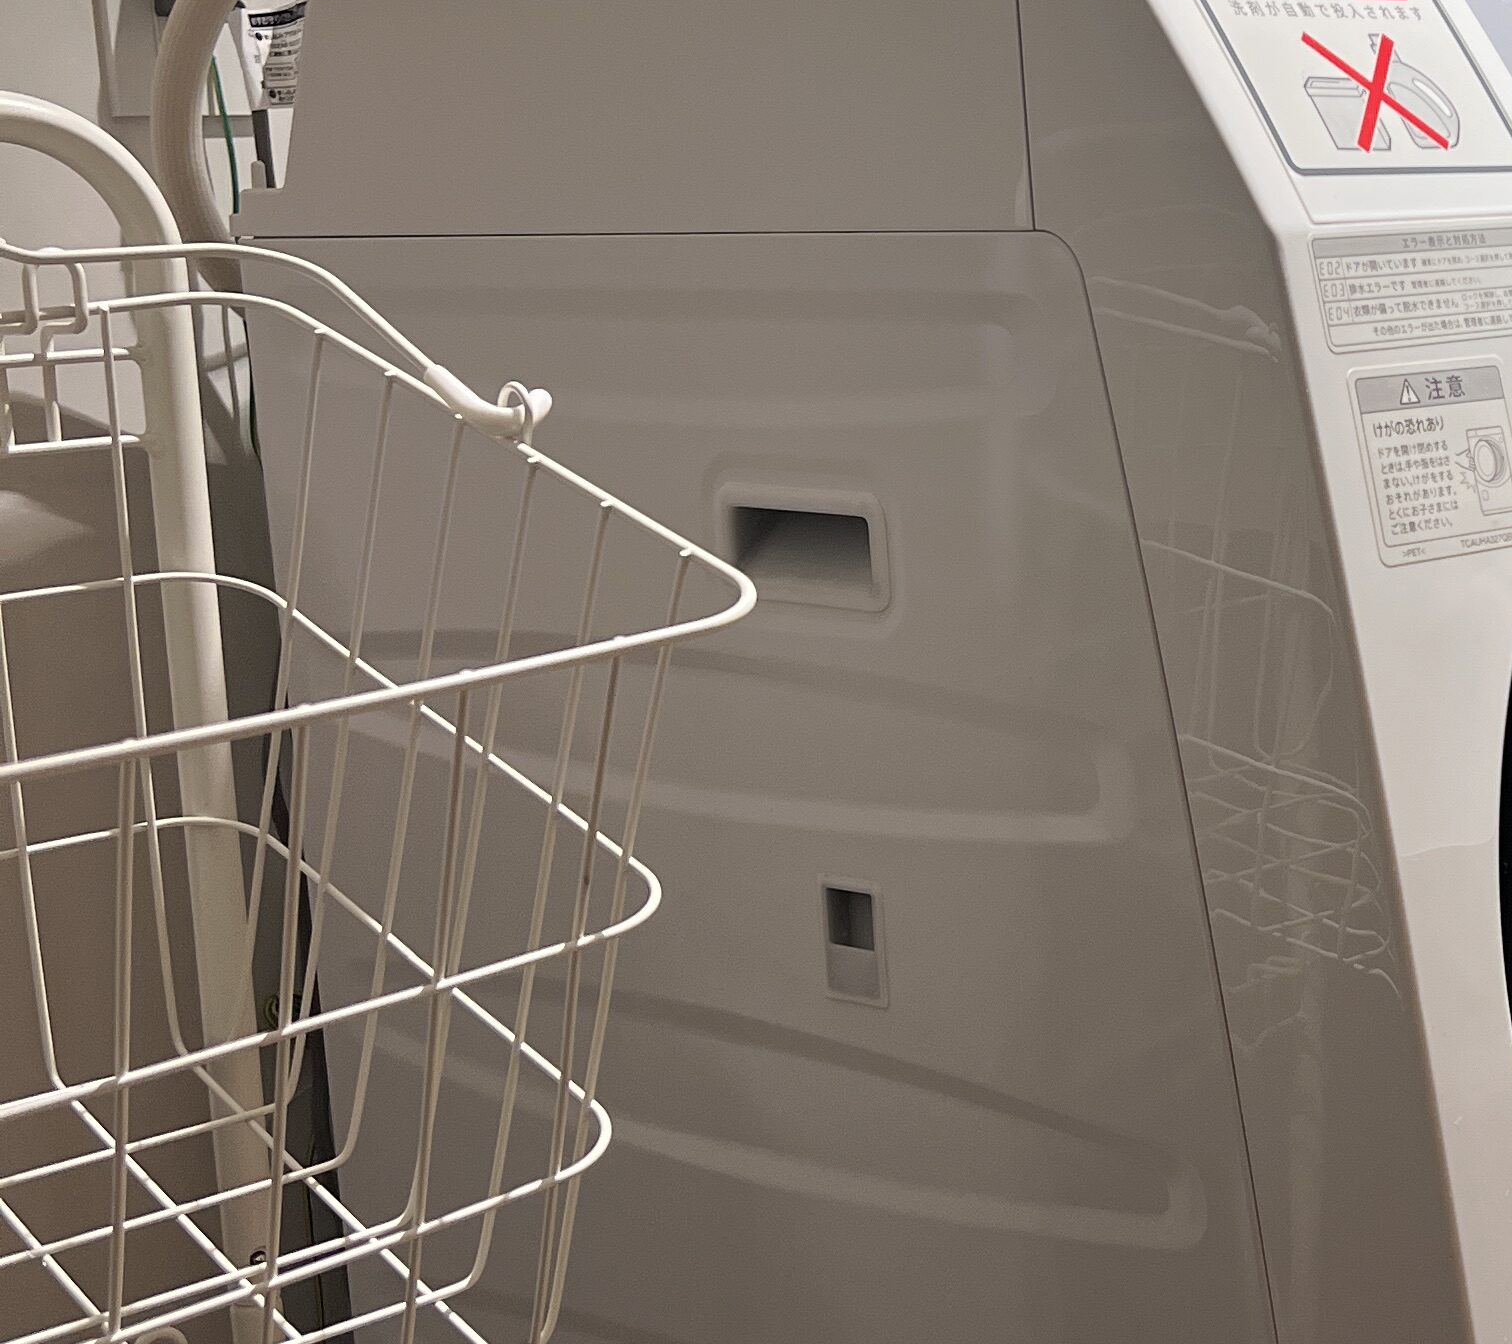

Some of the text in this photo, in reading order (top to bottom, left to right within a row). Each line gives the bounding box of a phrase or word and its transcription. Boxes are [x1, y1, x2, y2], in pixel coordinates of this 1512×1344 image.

[1424, 374, 1466, 401] 注意
[1372, 415, 1445, 439] けがの恐れあり
